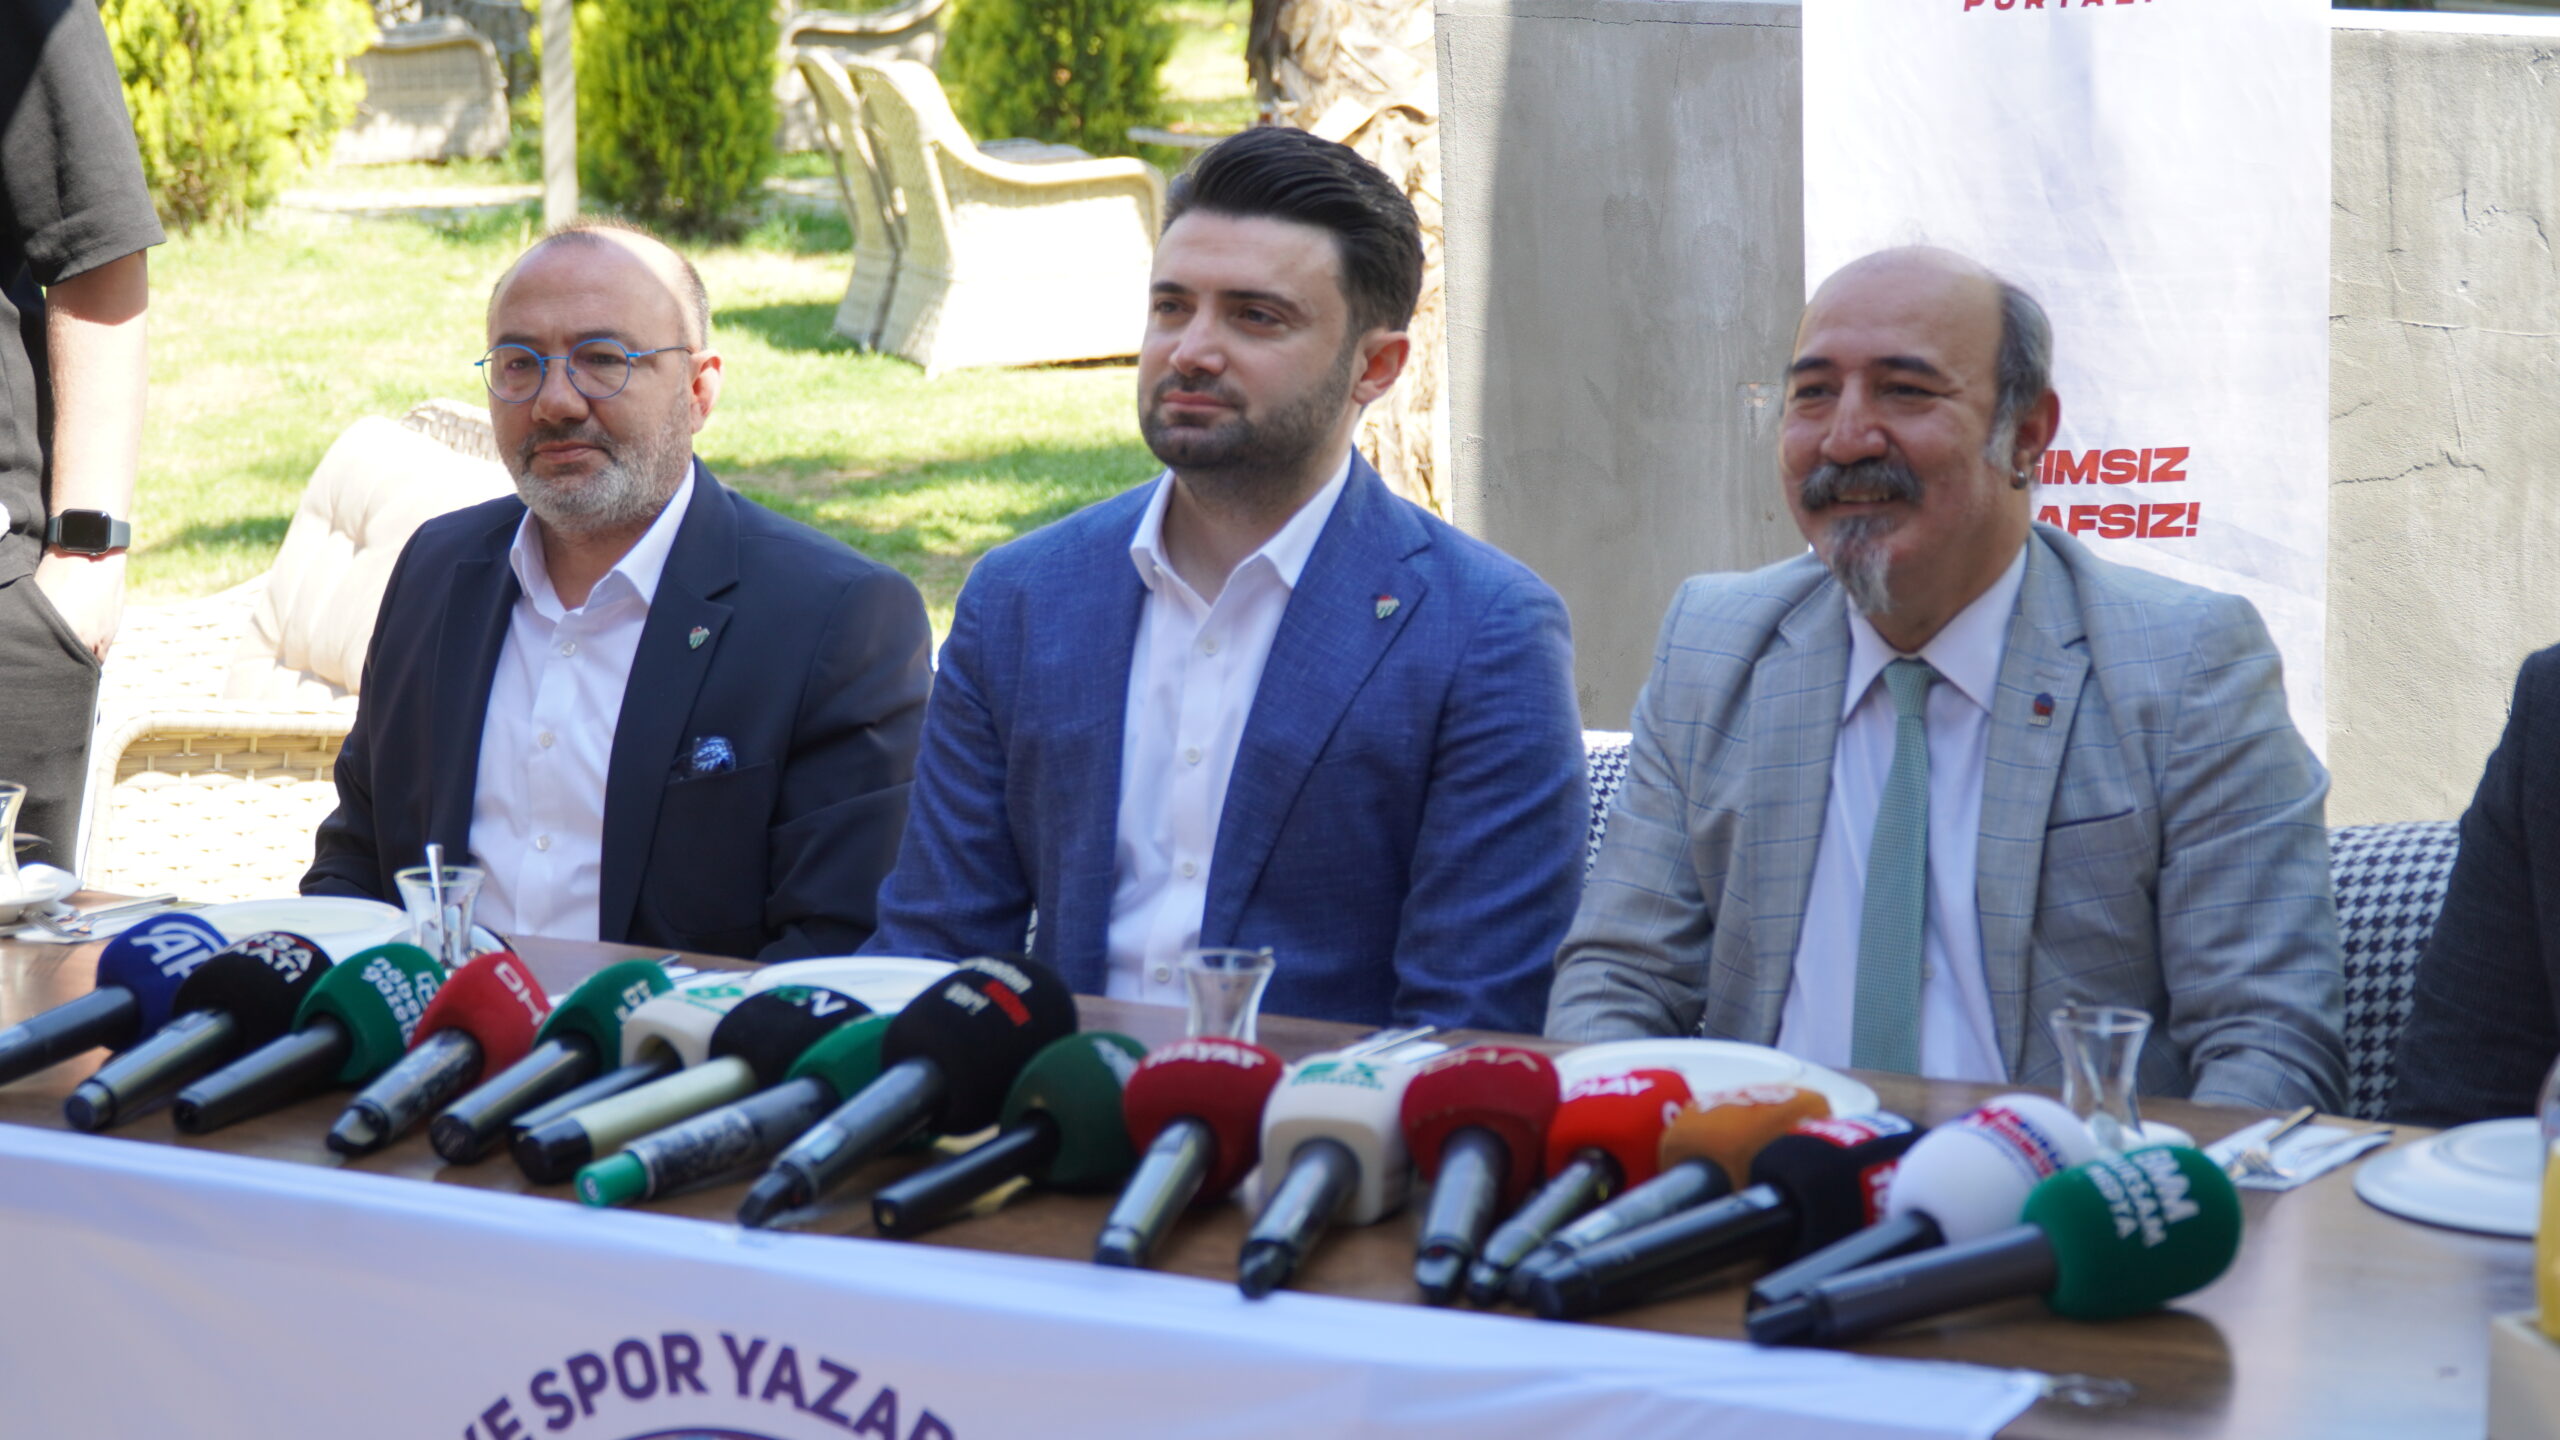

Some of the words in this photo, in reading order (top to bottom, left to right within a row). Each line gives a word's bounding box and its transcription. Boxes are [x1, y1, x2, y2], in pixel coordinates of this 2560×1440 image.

[2034, 446, 2190, 484] IMSIZ
[2036, 502, 2201, 539] AFSIZ!
[494, 961, 546, 1027] DH
[529, 1331, 710, 1432] SPOR
